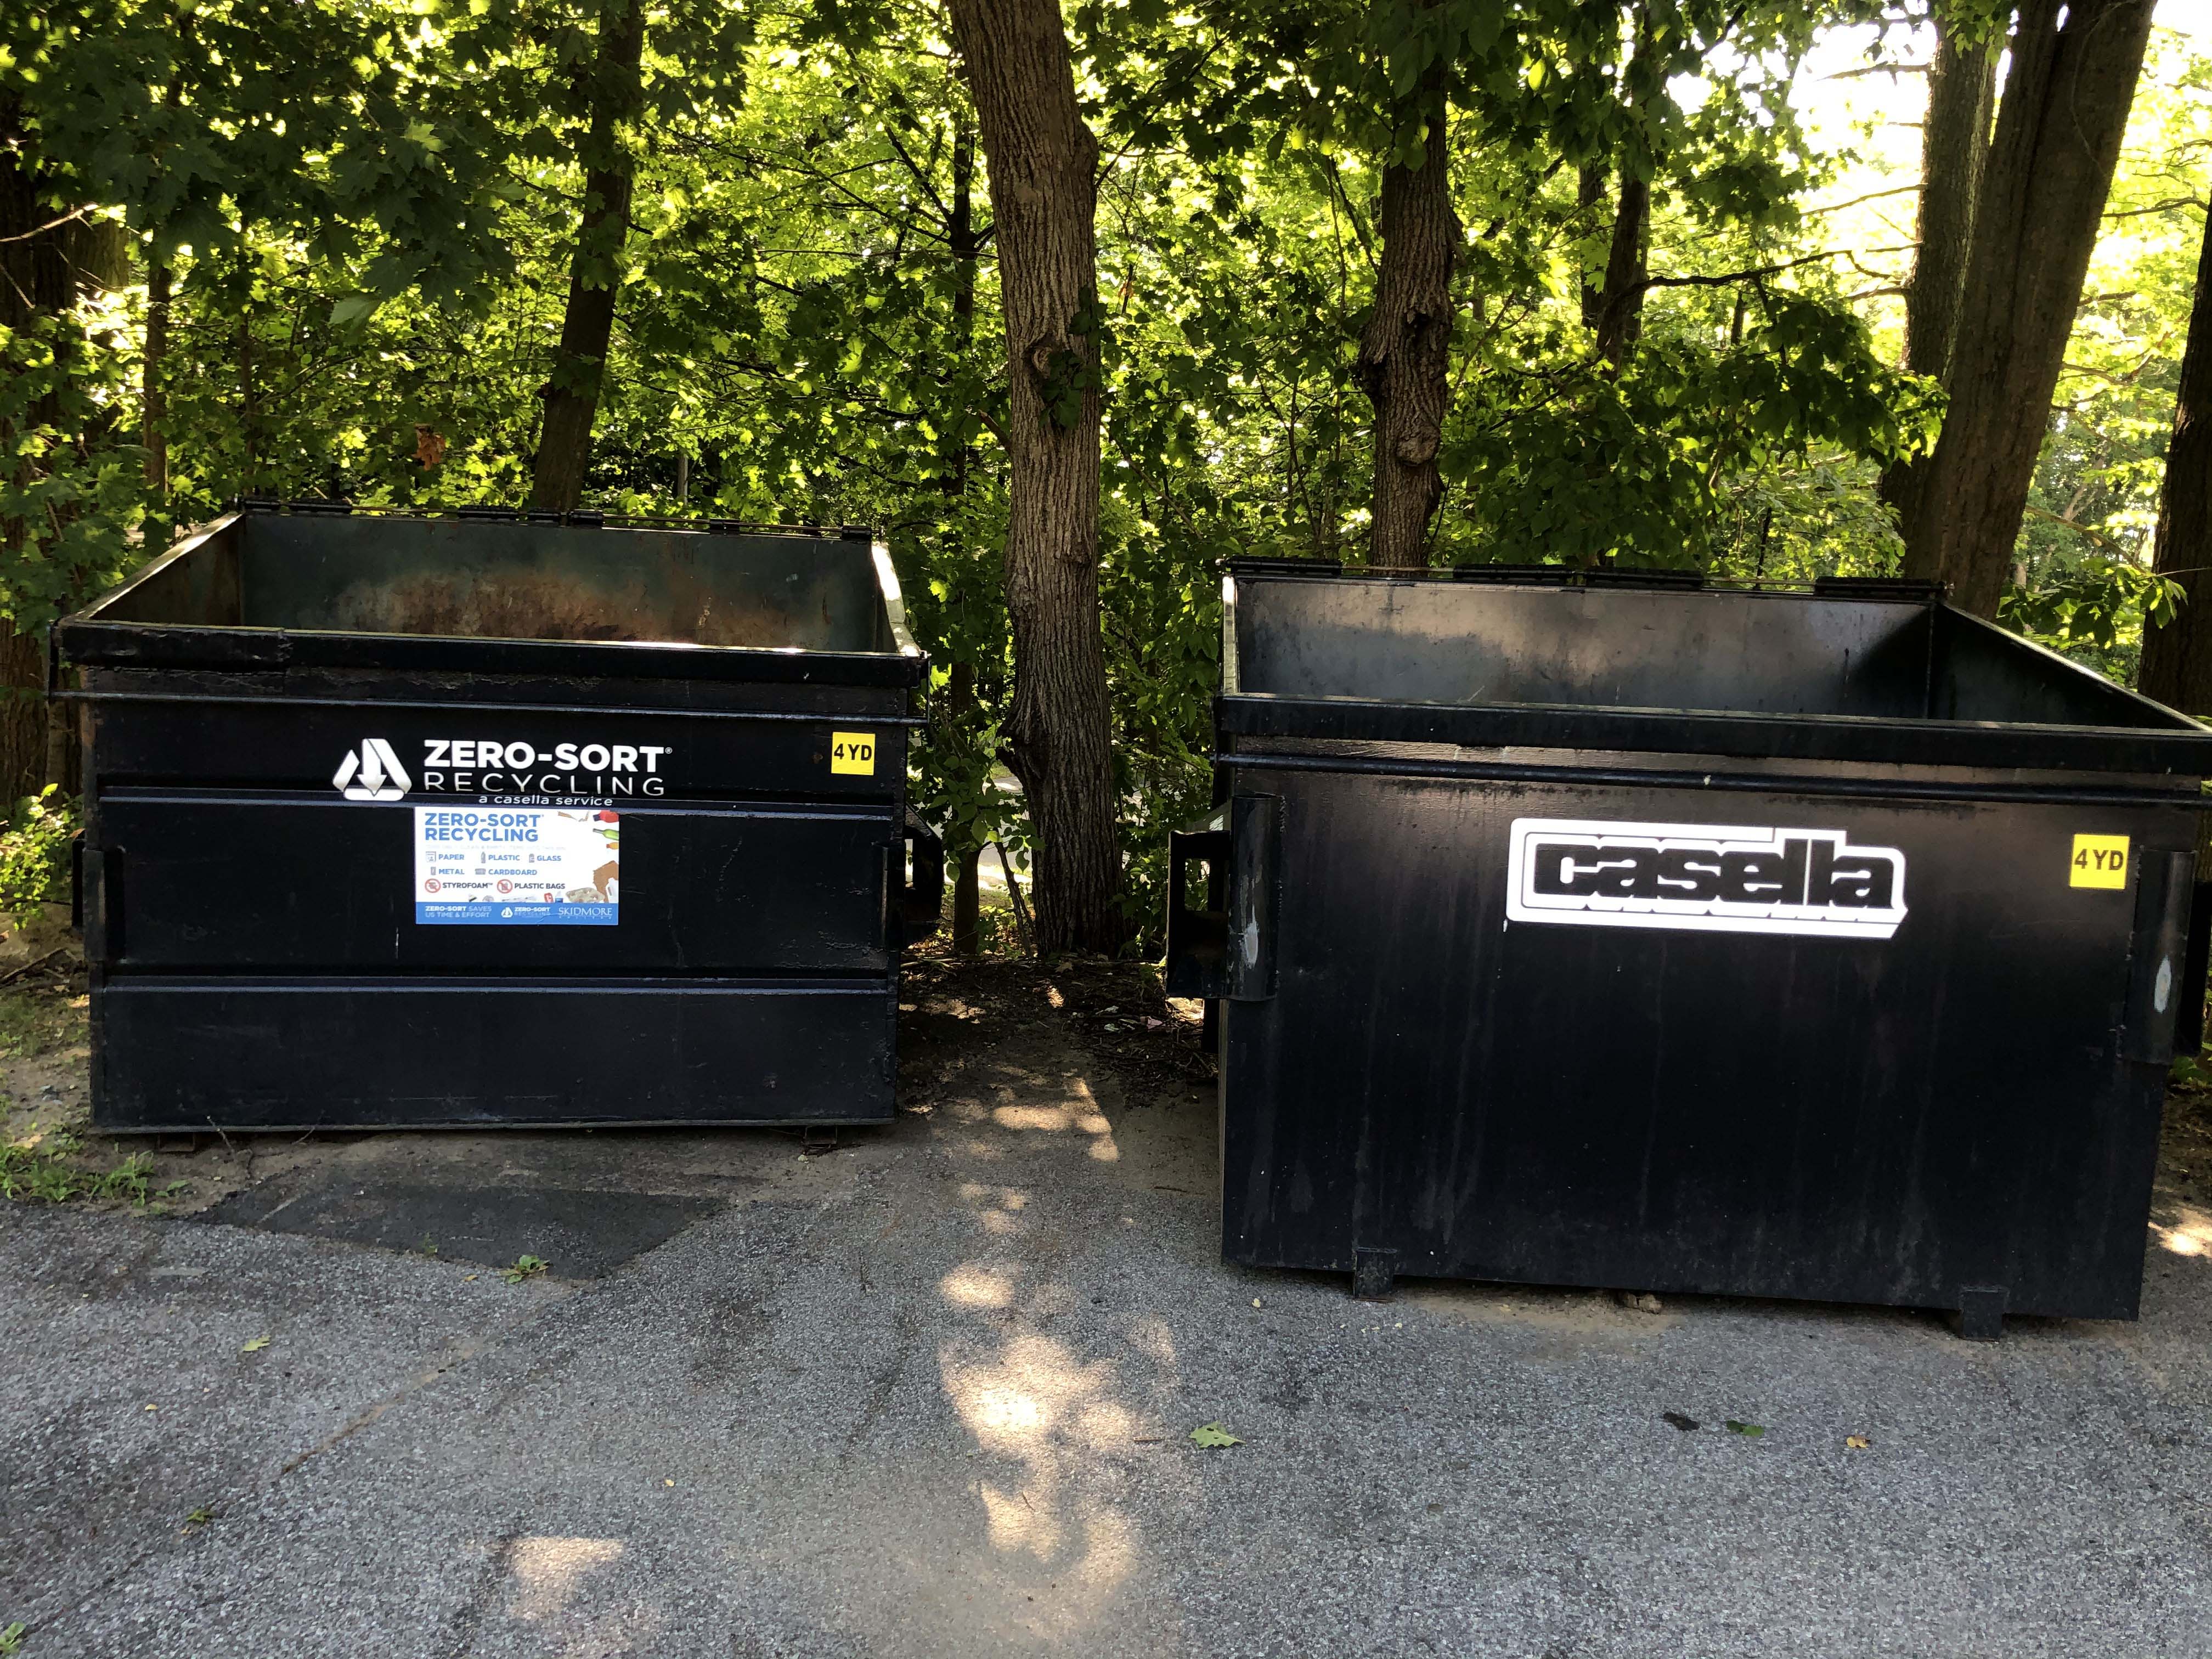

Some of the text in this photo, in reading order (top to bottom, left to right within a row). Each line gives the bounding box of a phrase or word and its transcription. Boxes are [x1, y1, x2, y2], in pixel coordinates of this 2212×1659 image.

[834, 743, 872, 761] 4 YD
[424, 771, 665, 797] RECYCLING
[493, 795, 550, 805] casella
[555, 797, 613, 807] service
[425, 827, 539, 842] RECYCLING
[2074, 848, 2124, 871] 4 YD
[1534, 838, 1895, 909] casella
[558, 907, 613, 916] SKIDMORE
